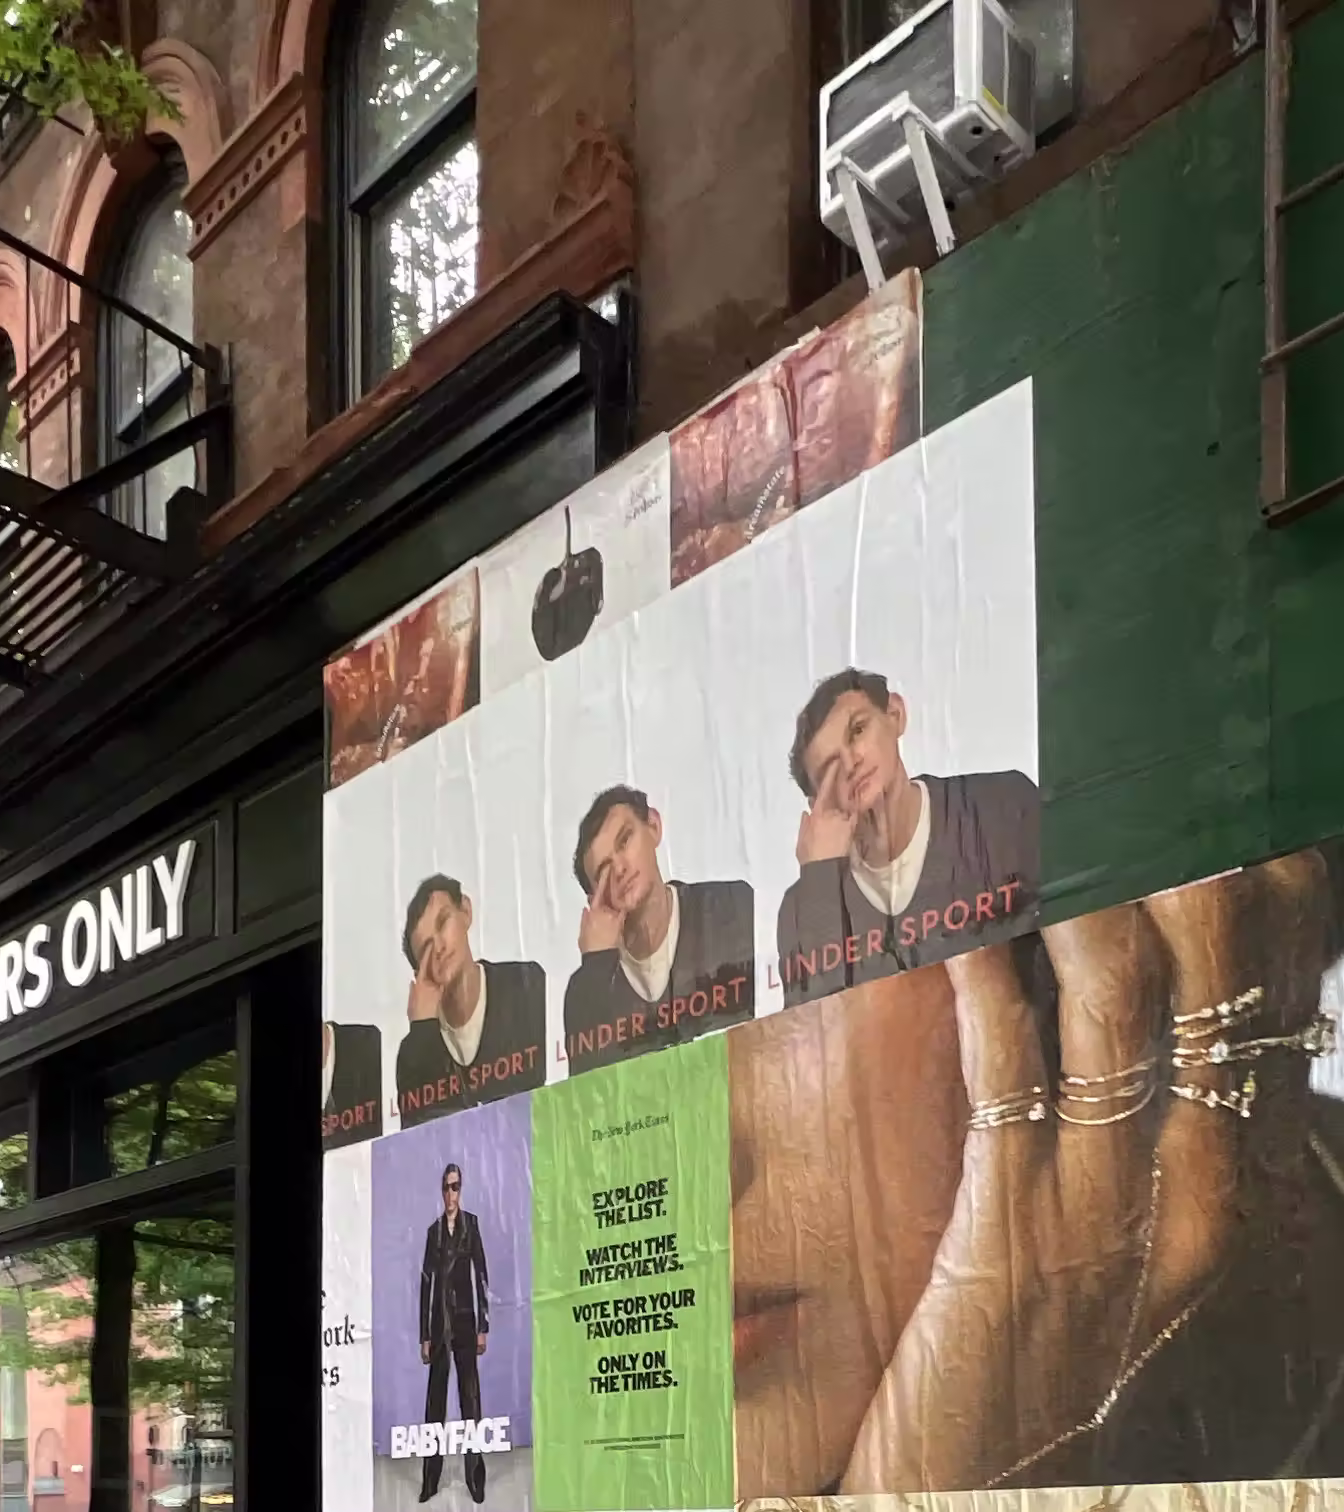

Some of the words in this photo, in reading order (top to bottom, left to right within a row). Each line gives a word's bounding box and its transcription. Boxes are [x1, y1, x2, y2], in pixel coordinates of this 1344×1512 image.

[61, 838, 197, 987] ONLY
[767, 928, 884, 990] LINDER
[899, 881, 1021, 947] SPORT
[555, 1012, 647, 1063] LINDER
[657, 976, 747, 1029] SPORT
[390, 1075, 459, 1118] LINDER
[468, 1045, 538, 1089] SPORT
[592, 1178, 669, 1210] EXPLORE
[594, 1205, 626, 1229] THE
[628, 1199, 667, 1223] LIST.
[586, 1239, 643, 1267] WATCH
[644, 1233, 678, 1255] THE
[579, 1253, 685, 1287] INTERVIEWS.
[572, 1300, 611, 1323] VOTE
[613, 1295, 647, 1318] FOR
[649, 1288, 696, 1313] YOUR
[586, 1311, 679, 1340] FAVORITES.
[597, 1352, 640, 1375] ONLY
[642, 1350, 666, 1371] ON
[589, 1375, 620, 1395] THE
[621, 1369, 678, 1393] TIMES.
[390, 1416, 512, 1459] BABYFACE
